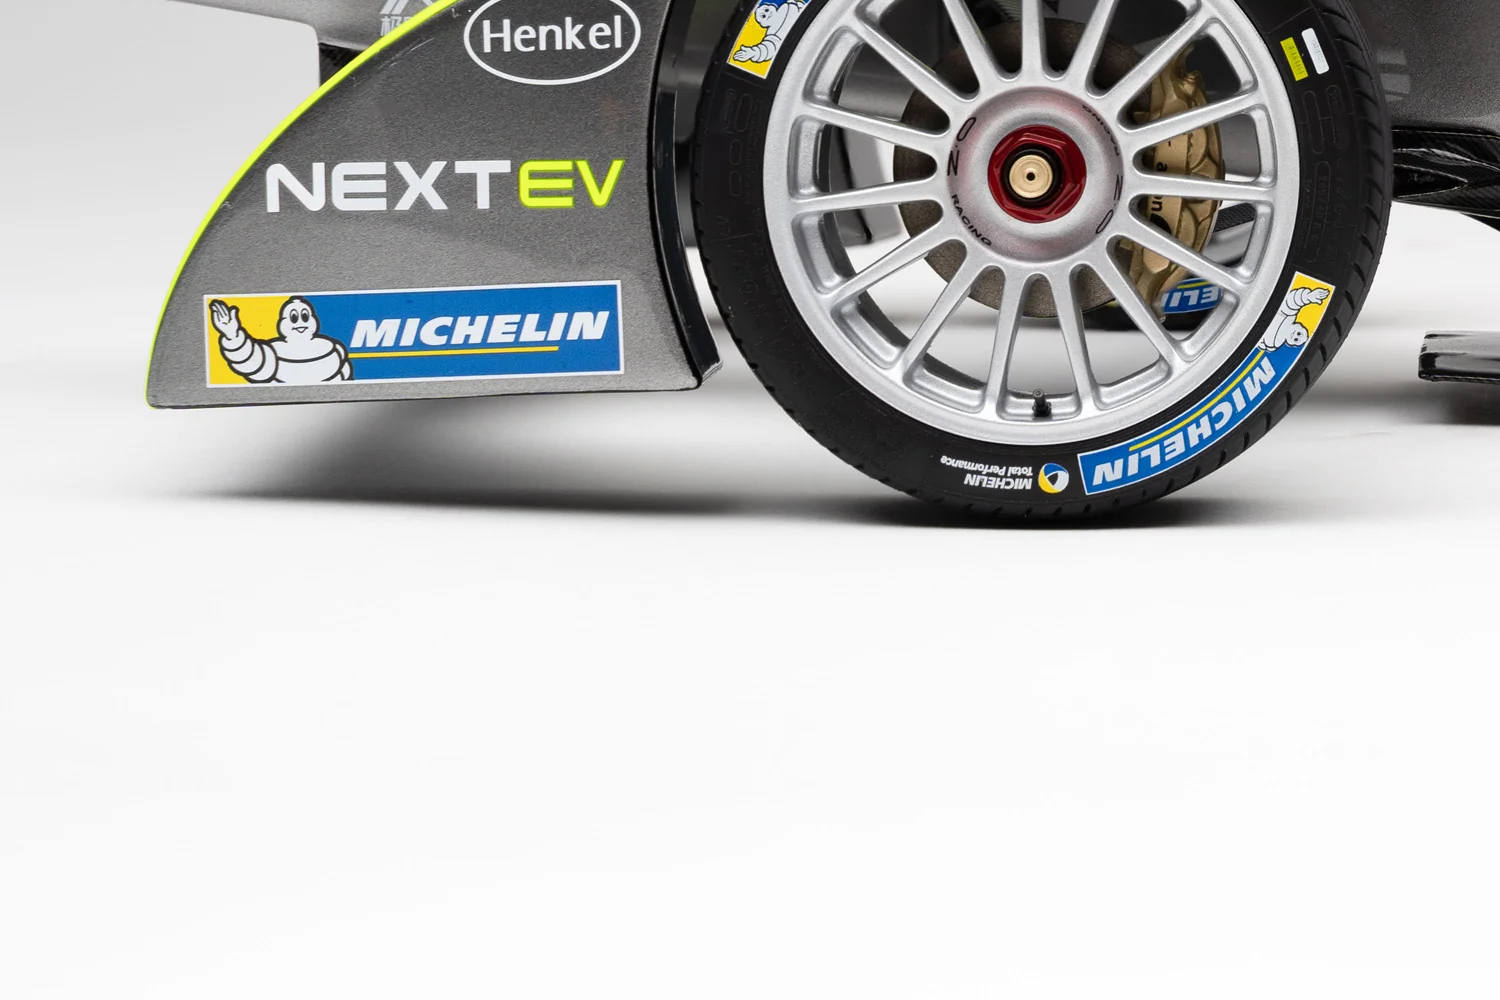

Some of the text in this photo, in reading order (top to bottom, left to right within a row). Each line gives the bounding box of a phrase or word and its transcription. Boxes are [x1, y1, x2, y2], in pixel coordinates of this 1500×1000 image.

[483, 15, 623, 54] Henkel
[951, 193, 993, 247] RACING
[350, 311, 611, 348] MICHELIN
[1092, 356, 1277, 487] MICHELIN
[940, 455, 1033, 478] Total Performance
[963, 472, 1034, 491] MICHELIN
